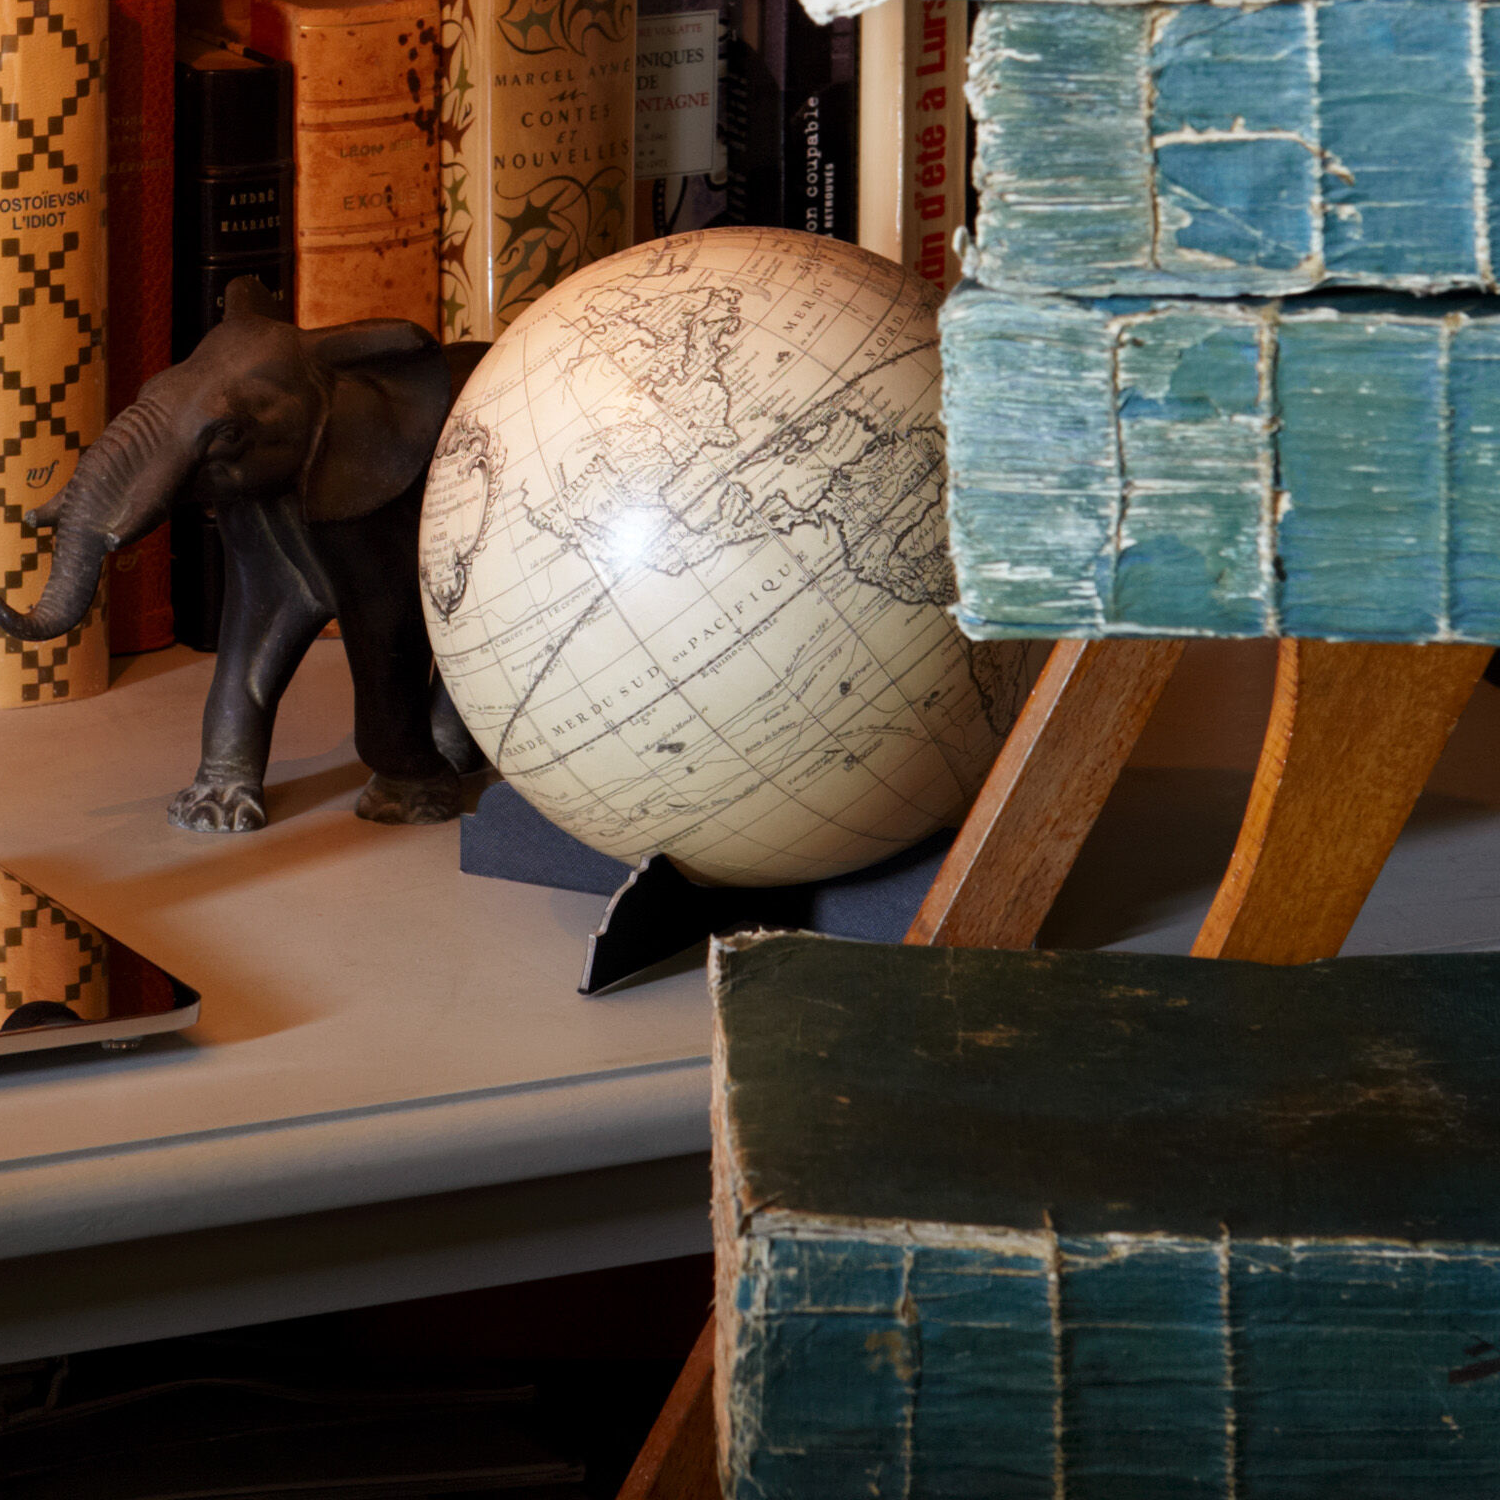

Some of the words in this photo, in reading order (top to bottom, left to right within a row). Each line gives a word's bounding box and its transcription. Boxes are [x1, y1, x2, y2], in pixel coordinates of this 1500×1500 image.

[494, 69, 575, 88] MARCEL
[636, 75, 659, 92] DE
[915, 86, 947, 111] à
[520, 105, 611, 128] CONTES
[555, 129, 578, 145] ET
[803, 95, 822, 198] coupable
[493, 137, 631, 171] NOUVELLES
[915, 124, 947, 222] d'été
[11, 212, 68, 232] L'IDIOT
[782, 300, 817, 334] MER
[812, 278, 834, 298] DU
[864, 314, 906, 362] NORD
[25, 458, 60, 490] nrf
[551, 711, 591, 738] MER
[590, 695, 615, 716] DU
[619, 665, 662, 698] SUD
[672, 649, 690, 664] ou
[688, 551, 810, 651] PACIFIQUE
